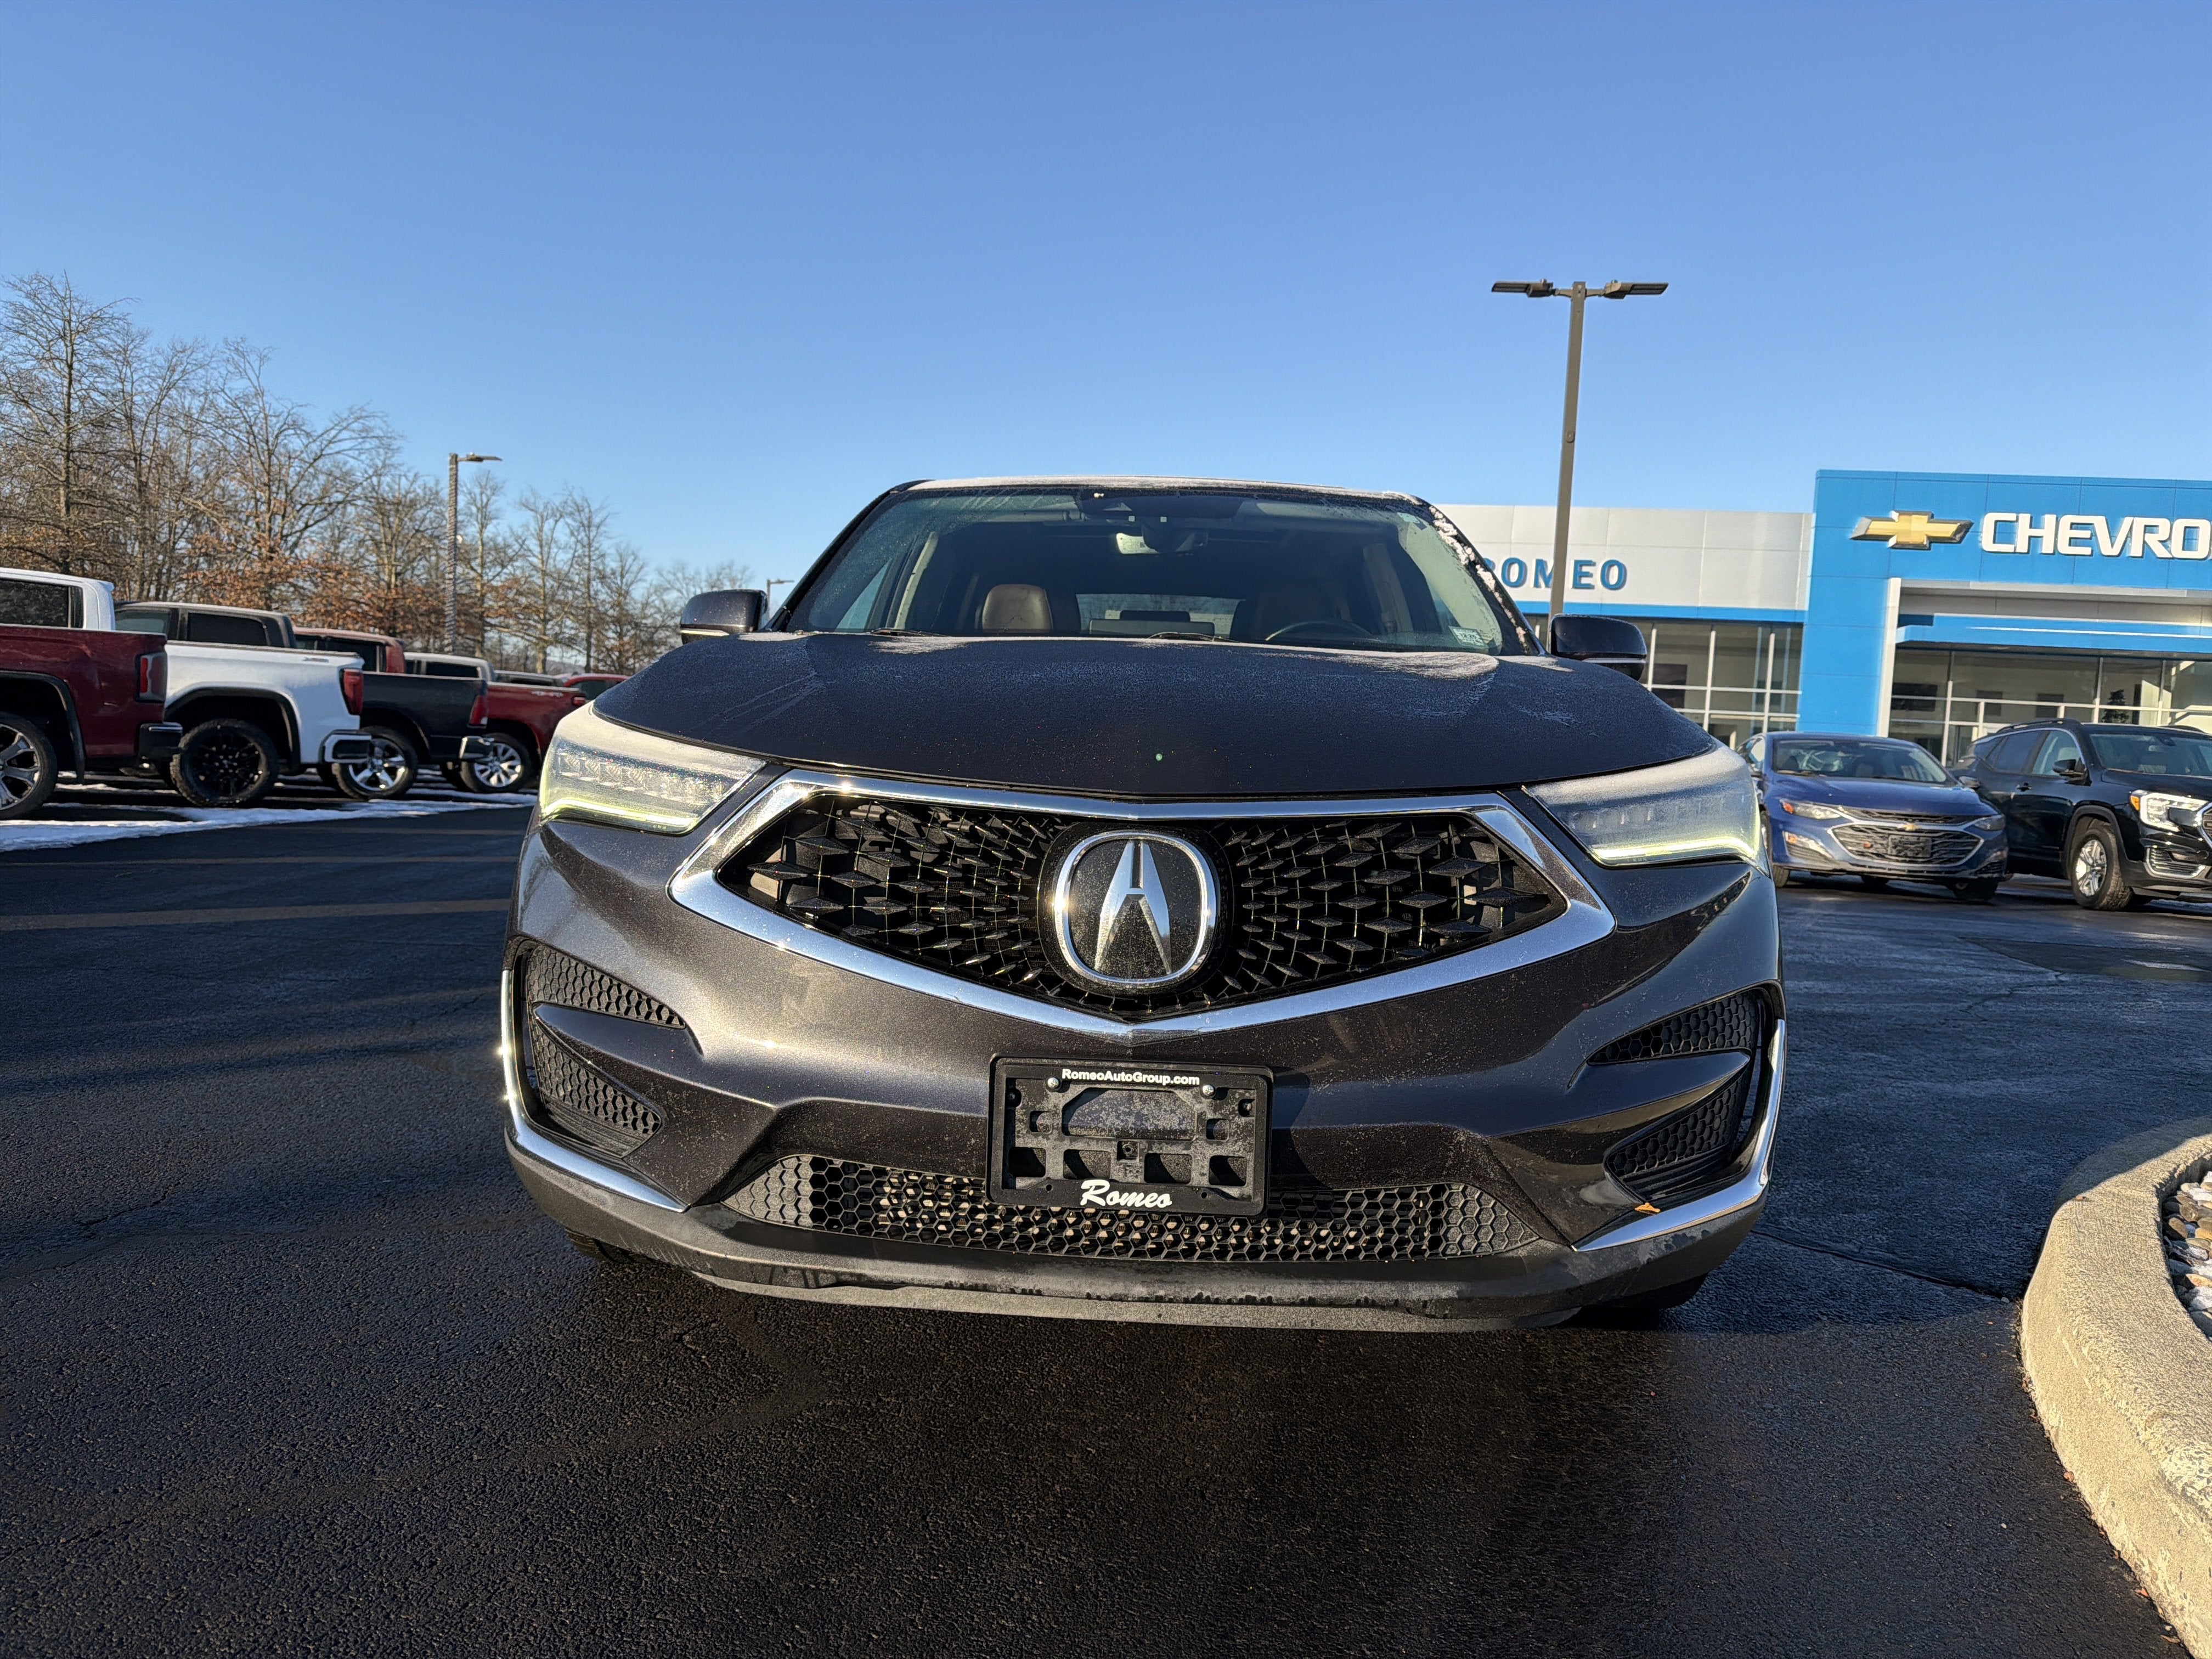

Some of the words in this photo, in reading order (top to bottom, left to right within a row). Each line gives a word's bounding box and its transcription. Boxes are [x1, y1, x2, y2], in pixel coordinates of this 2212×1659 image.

[1981, 512, 2211, 560] CHEVRO
[1062, 1068, 1200, 1086] RomeoAutoGroup.com
[1080, 1179, 1172, 1208] Romeo
